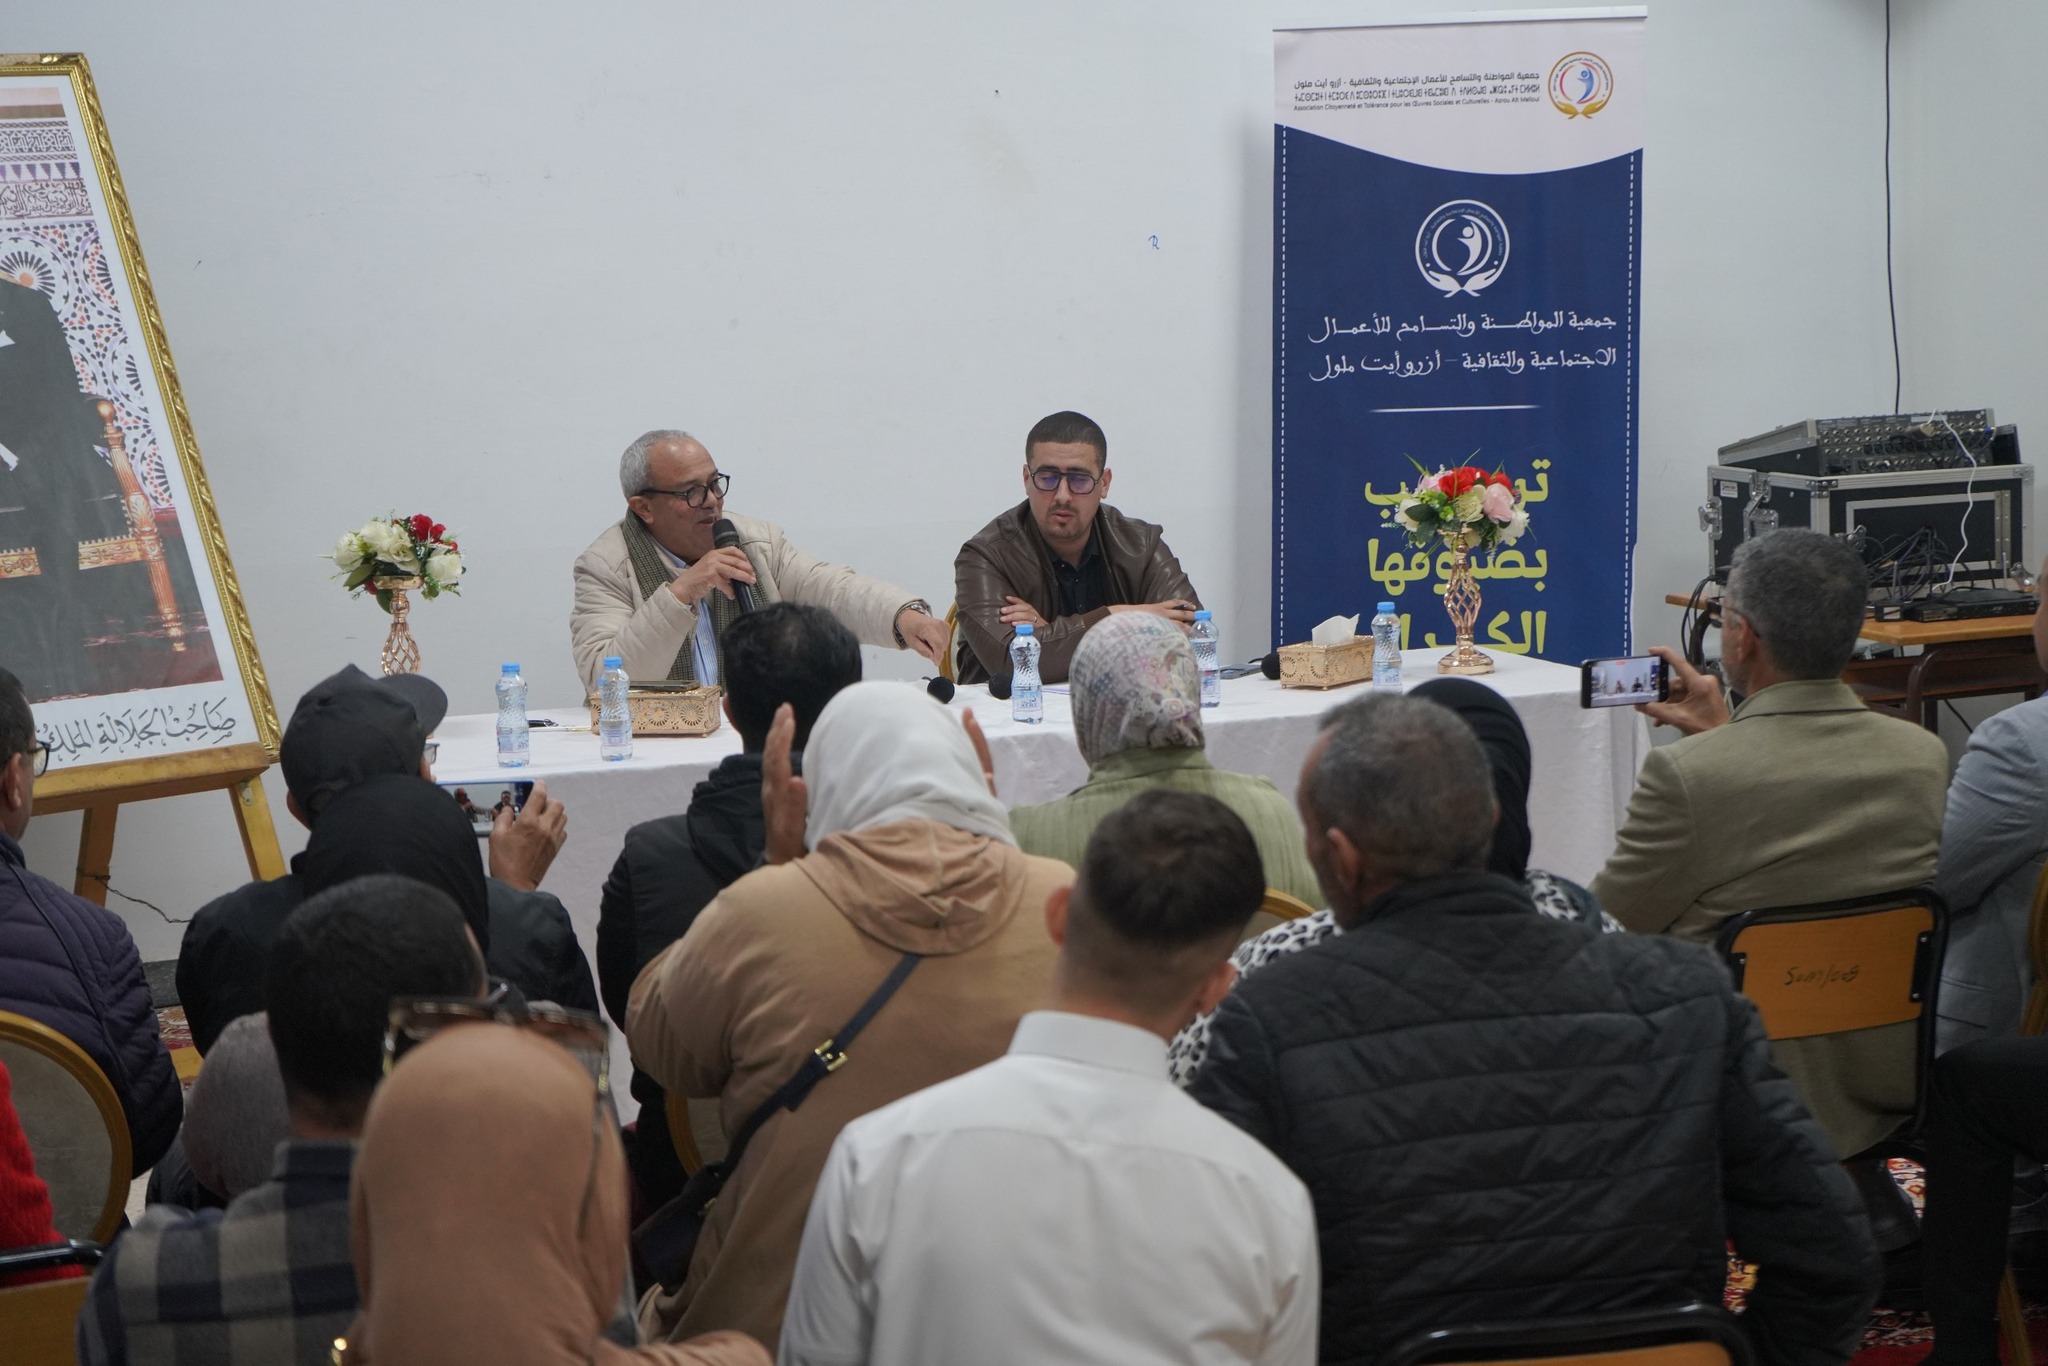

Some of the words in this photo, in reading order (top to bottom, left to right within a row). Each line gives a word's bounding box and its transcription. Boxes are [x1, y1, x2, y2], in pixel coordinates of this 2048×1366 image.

[1350, 77, 1381, 87] والثقافية
[1450, 73, 1481, 85] والتسامح
[1484, 72, 1514, 82] المواطنة
[1517, 72, 1540, 81] جمعية
[1294, 80, 1312, 90] ملول
[1325, 103, 1355, 111] Citoyenneté
[1308, 312, 1391, 344] للأعمال
[1396, 312, 1476, 341] والتسامح
[1481, 310, 1564, 334] المواطنة
[1568, 312, 1616, 330] جمعية
[1308, 354, 1355, 382] ملول
[1462, 350, 1525, 374] والثقافية
